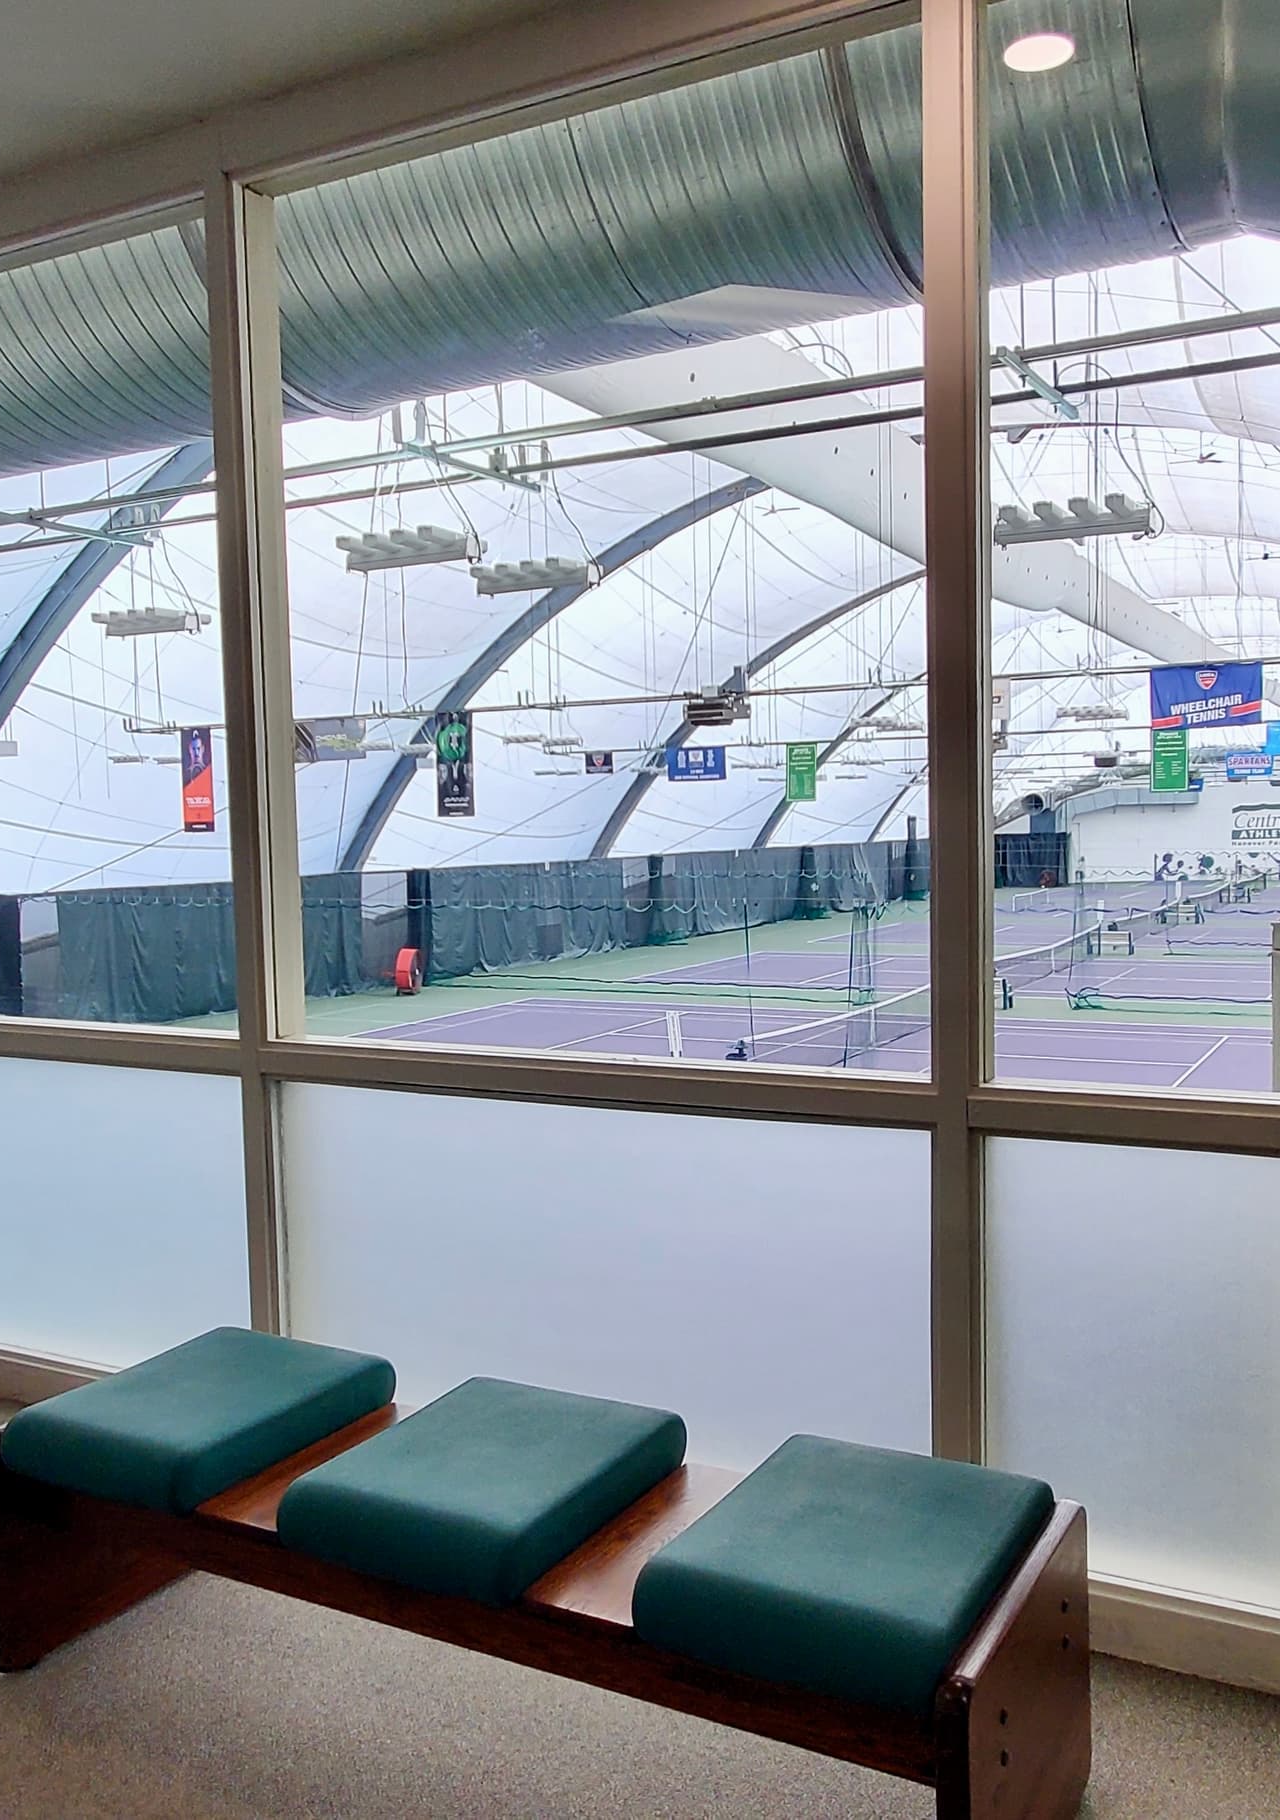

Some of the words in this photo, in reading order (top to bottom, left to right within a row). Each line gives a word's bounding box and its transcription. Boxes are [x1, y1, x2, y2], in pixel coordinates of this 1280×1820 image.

[1170, 694, 1243, 715] WHEELCHAIR
[1185, 708, 1226, 724] TENNIS
[1228, 757, 1271, 766] SPARTANS
